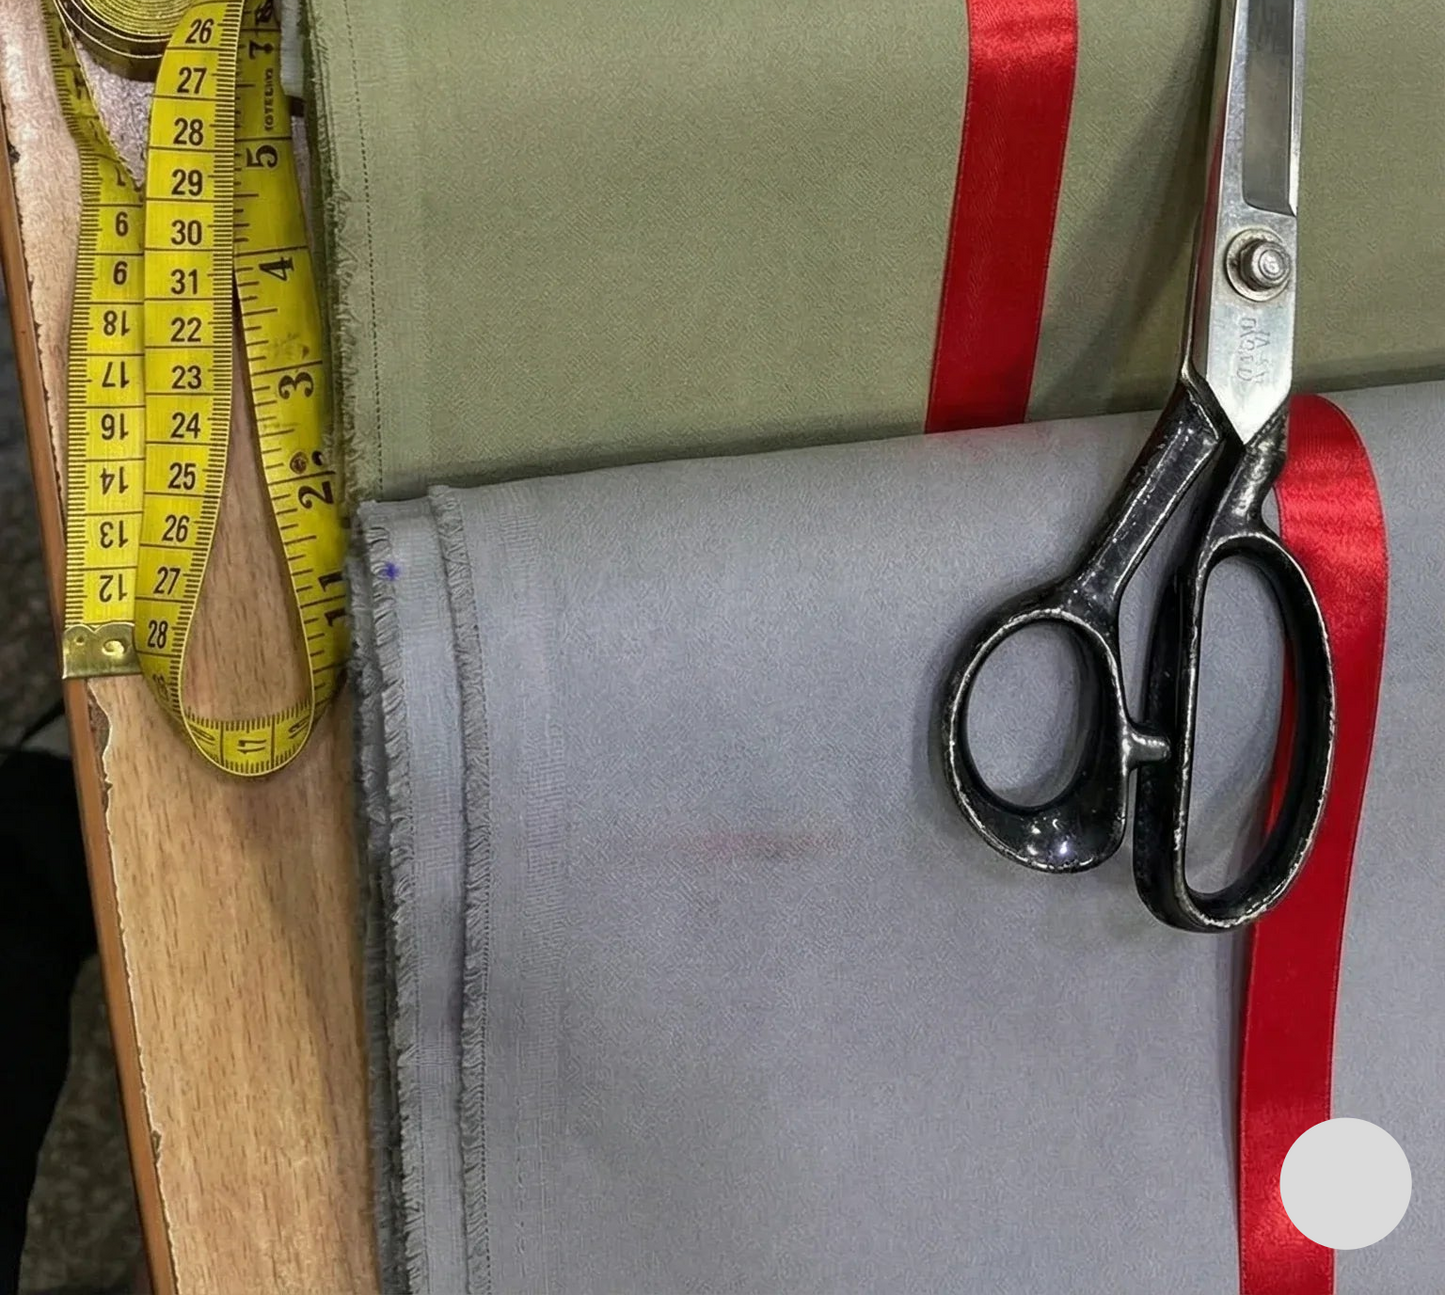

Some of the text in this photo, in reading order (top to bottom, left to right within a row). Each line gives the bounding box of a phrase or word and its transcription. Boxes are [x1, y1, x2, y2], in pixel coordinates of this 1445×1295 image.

[185, 18, 214, 44] 26
[177, 66, 207, 94] 27
[173, 117, 204, 146] 28
[246, 144, 278, 169] 5
[171, 168, 203, 196] 29
[171, 219, 202, 245] 30
[170, 268, 198, 295] 31
[258, 257, 295, 281] 4
[103, 310, 130, 336] 18
[170, 317, 202, 343] 22
[102, 361, 130, 388] 17
[171, 365, 202, 390] 23
[278, 371, 314, 400] 3
[101, 413, 129, 440] 16
[170, 412, 201, 439] 24
[100, 466, 129, 495] 14
[168, 462, 196, 490] 25
[297, 480, 335, 509] 2
[99, 520, 128, 548] 13
[162, 514, 190, 543] 26
[99, 573, 128, 603] 12
[153, 566, 181, 595] 27
[147, 620, 168, 649] 28
